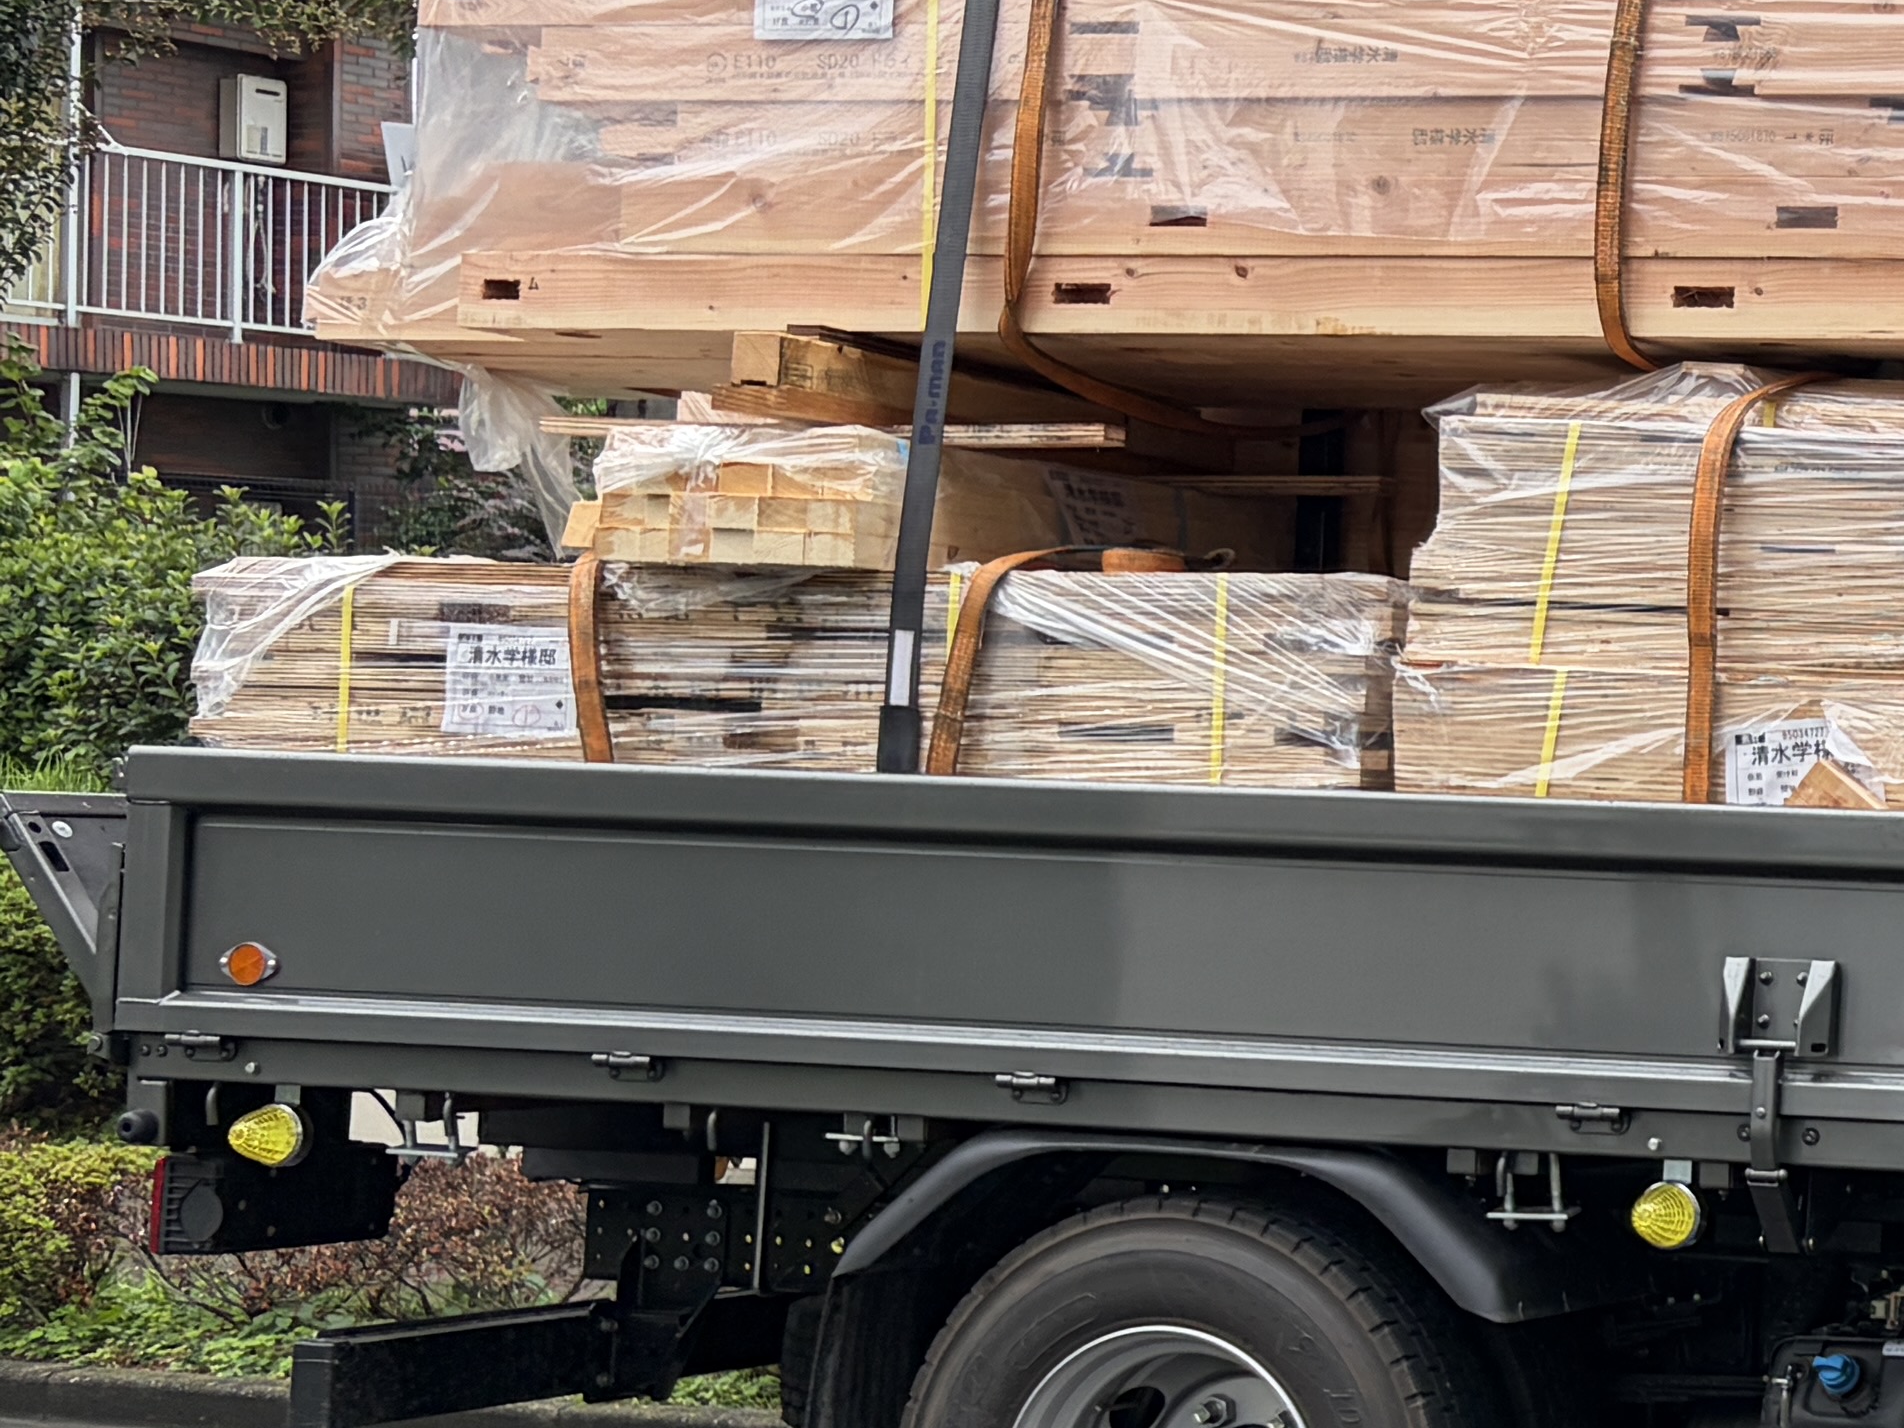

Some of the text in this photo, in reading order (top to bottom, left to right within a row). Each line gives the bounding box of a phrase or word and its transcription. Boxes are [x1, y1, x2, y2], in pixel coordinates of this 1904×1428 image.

[468, 644, 557, 666] 清水学様邸
